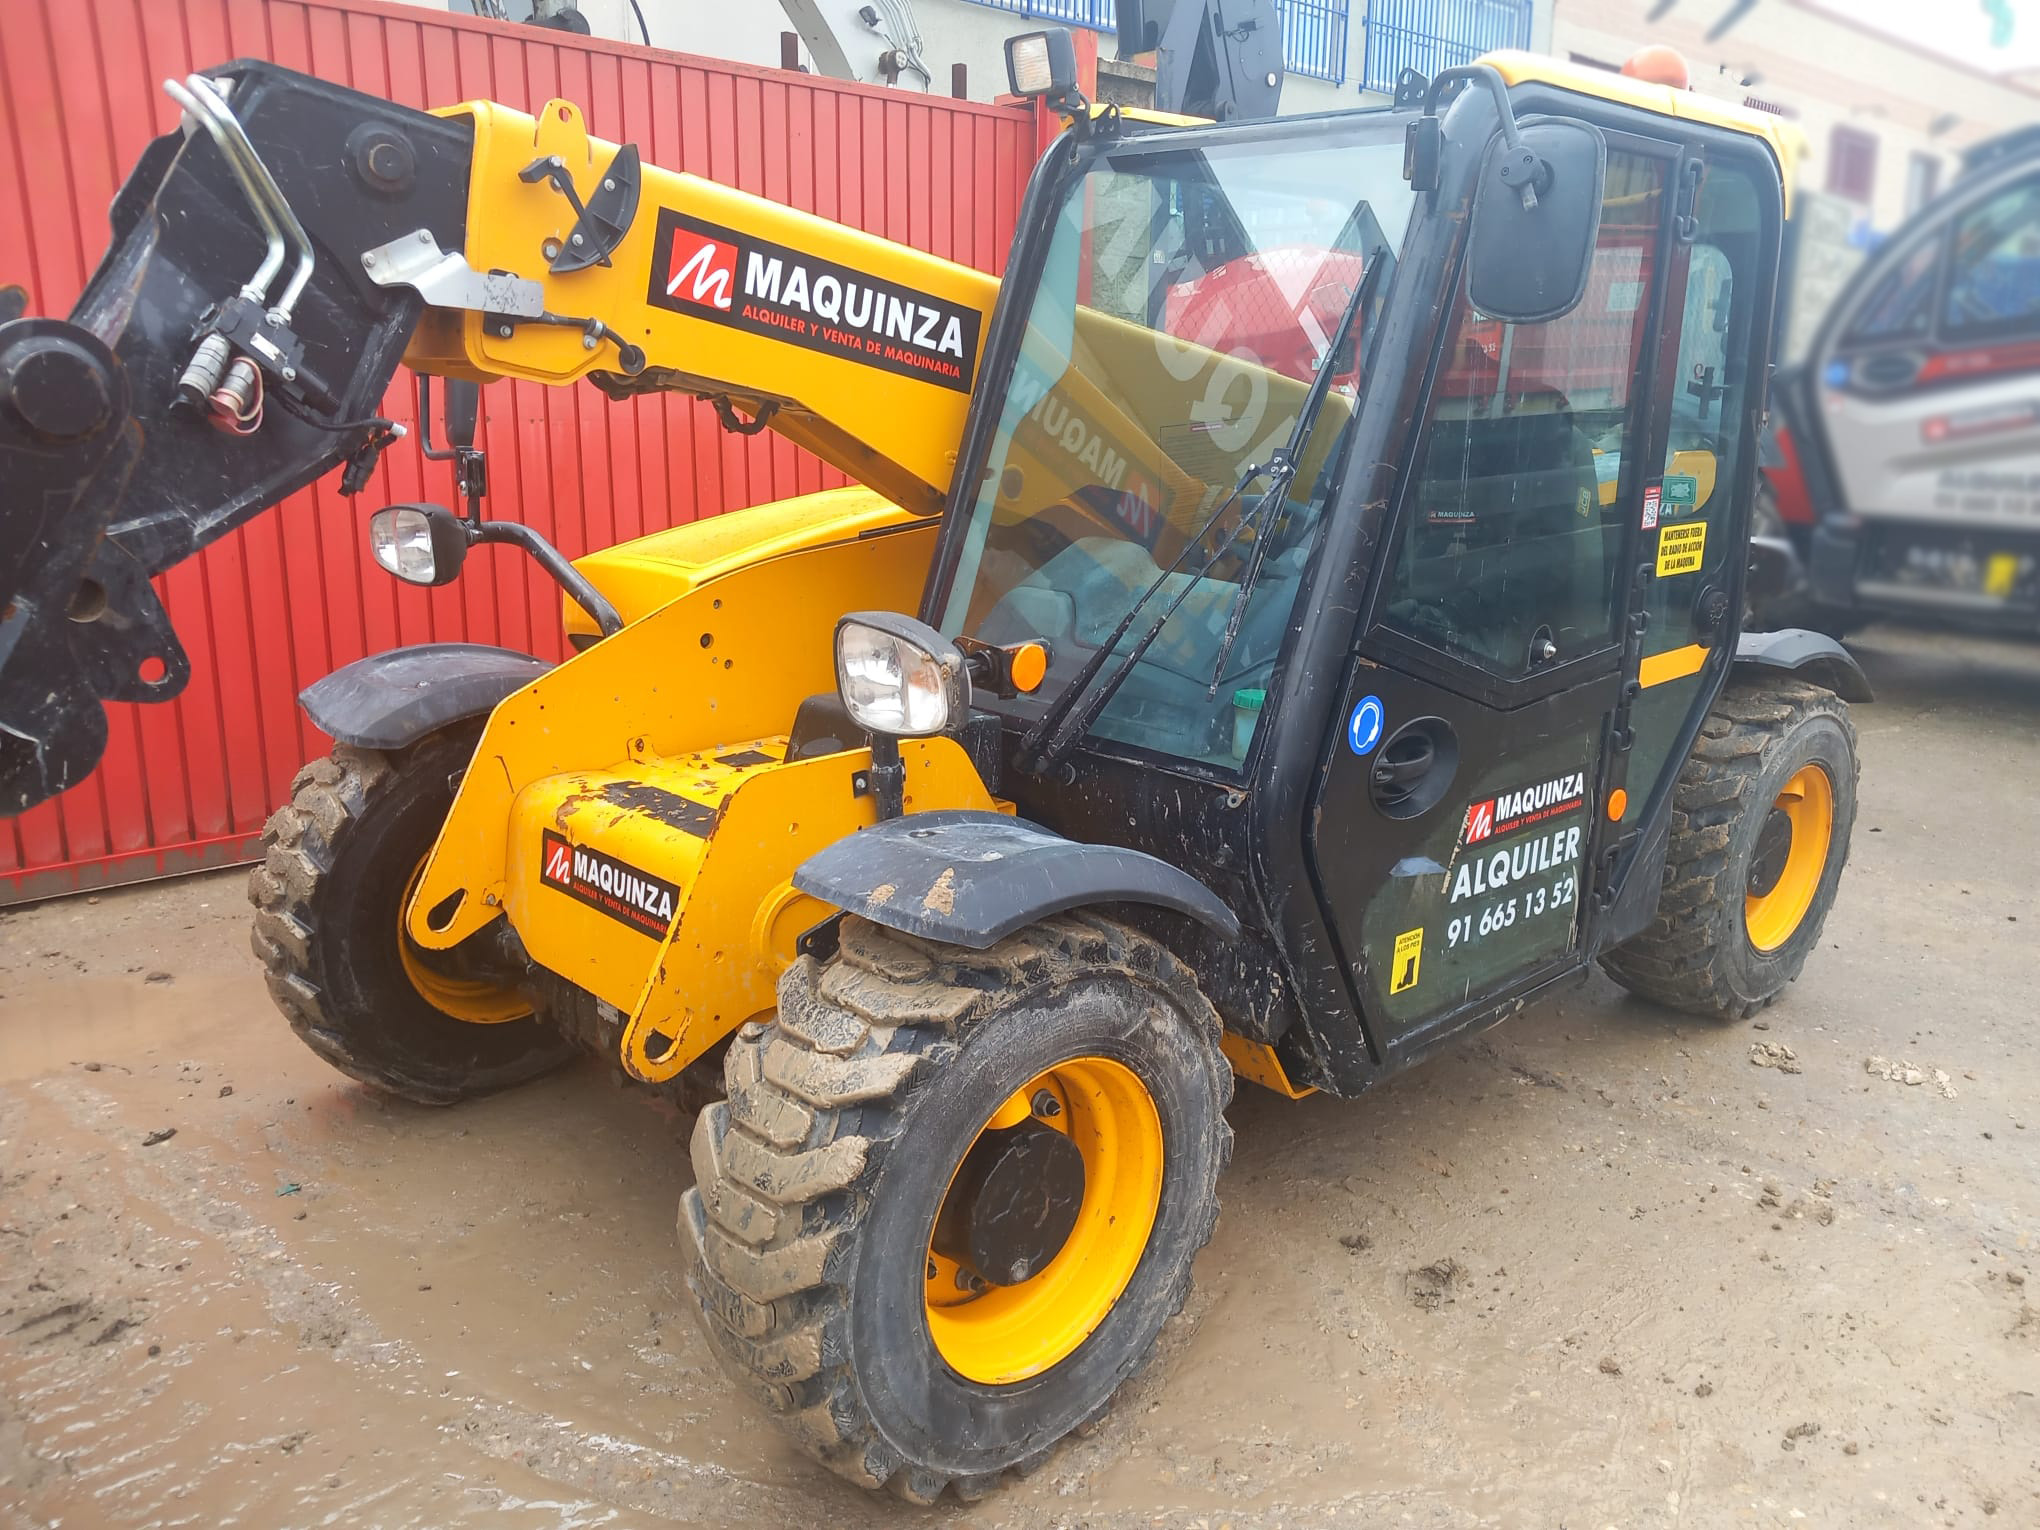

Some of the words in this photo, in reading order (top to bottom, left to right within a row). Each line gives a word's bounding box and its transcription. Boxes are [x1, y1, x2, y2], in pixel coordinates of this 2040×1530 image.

[744, 251, 963, 358] MAQUINZA
[742, 304, 806, 334] ALQUILER
[810, 323, 819, 338] Y
[823, 327, 862, 351] VENTA
[866, 340, 881, 356] DE
[884, 346, 961, 379] MAQUINARIA
[1495, 772, 1583, 822] MAQUINZA
[1495, 820, 1520, 834] ALQUILER
[1521, 817, 1525, 825] Y
[1525, 812, 1542, 823] VENTA
[1542, 809, 1550, 818] DE
[573, 850, 672, 922] MAQUINZA
[573, 882, 598, 900] ALQUILER
[599, 894, 604, 902] Y
[604, 896, 622, 912] VENTA
[622, 905, 630, 917] DE
[1450, 826, 1581, 904] ALQUILER
[1447, 914, 1472, 948] 91
[1479, 898, 1517, 936] 665
[1525, 887, 1546, 919] 13
[1550, 877, 1574, 910] 52
